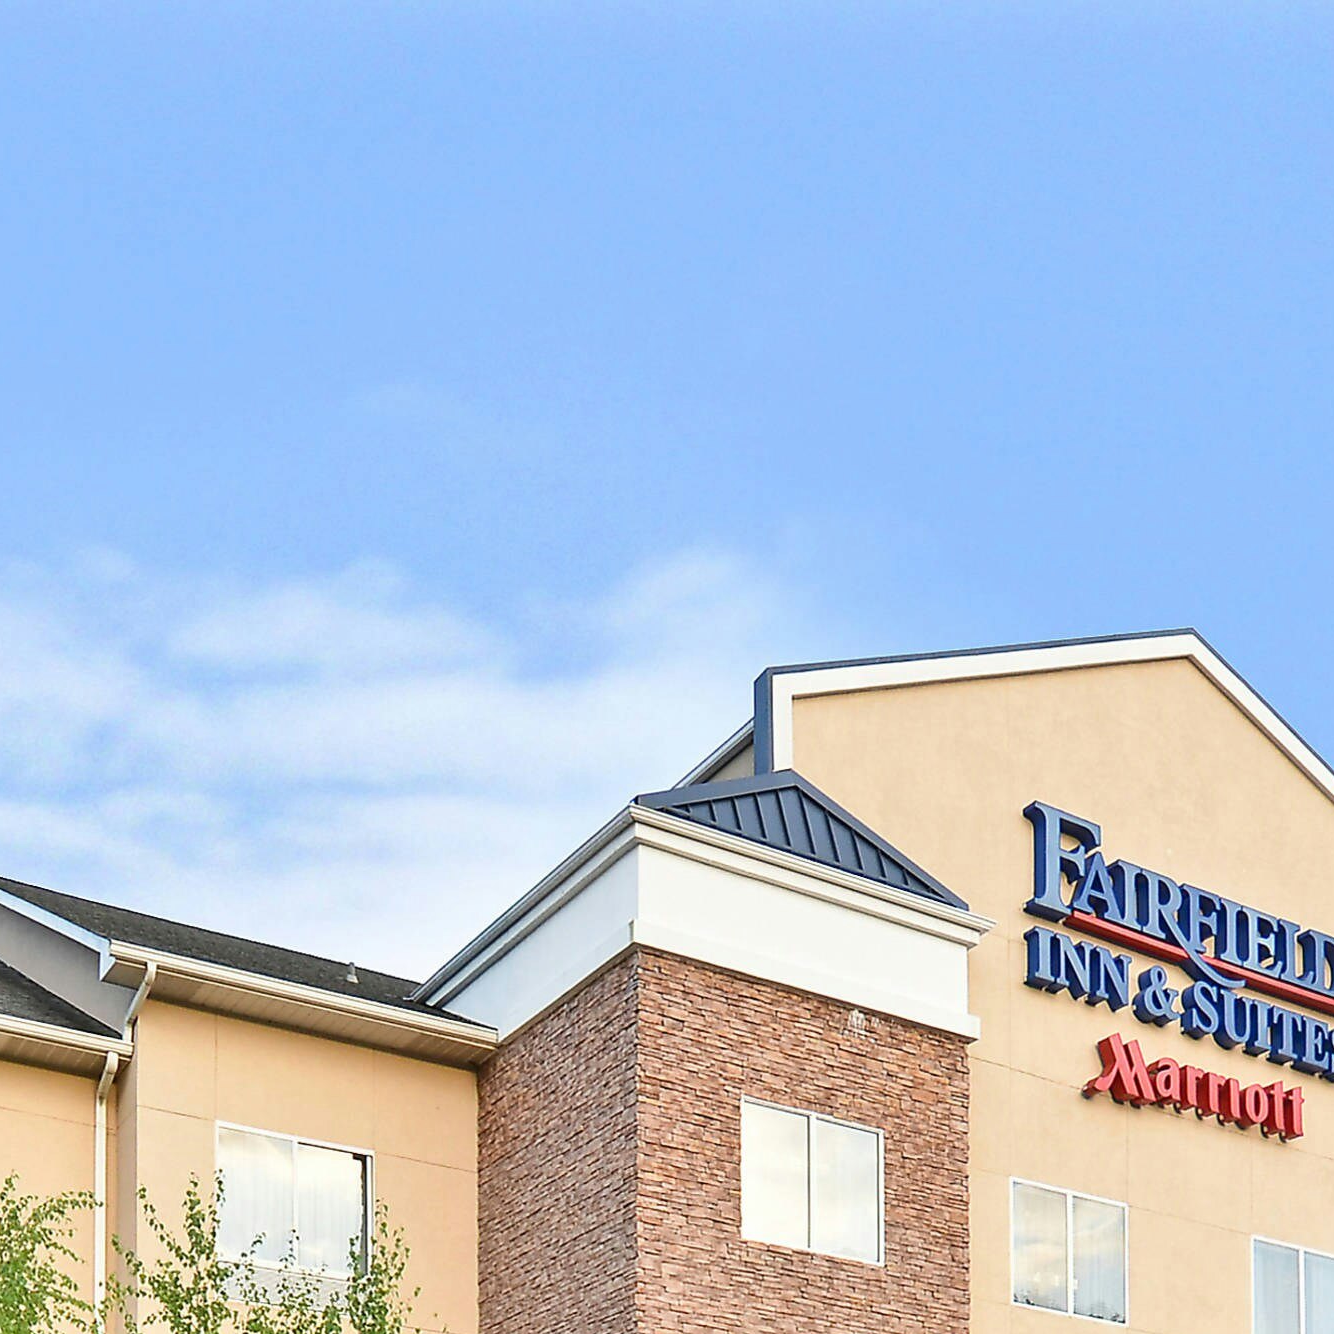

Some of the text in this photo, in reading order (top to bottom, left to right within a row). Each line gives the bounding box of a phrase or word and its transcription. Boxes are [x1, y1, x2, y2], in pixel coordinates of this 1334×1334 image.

[1024, 926, 1133, 1012] INN
[1132, 965, 1181, 1028] &
[1081, 1032, 1306, 1142] Marriott
